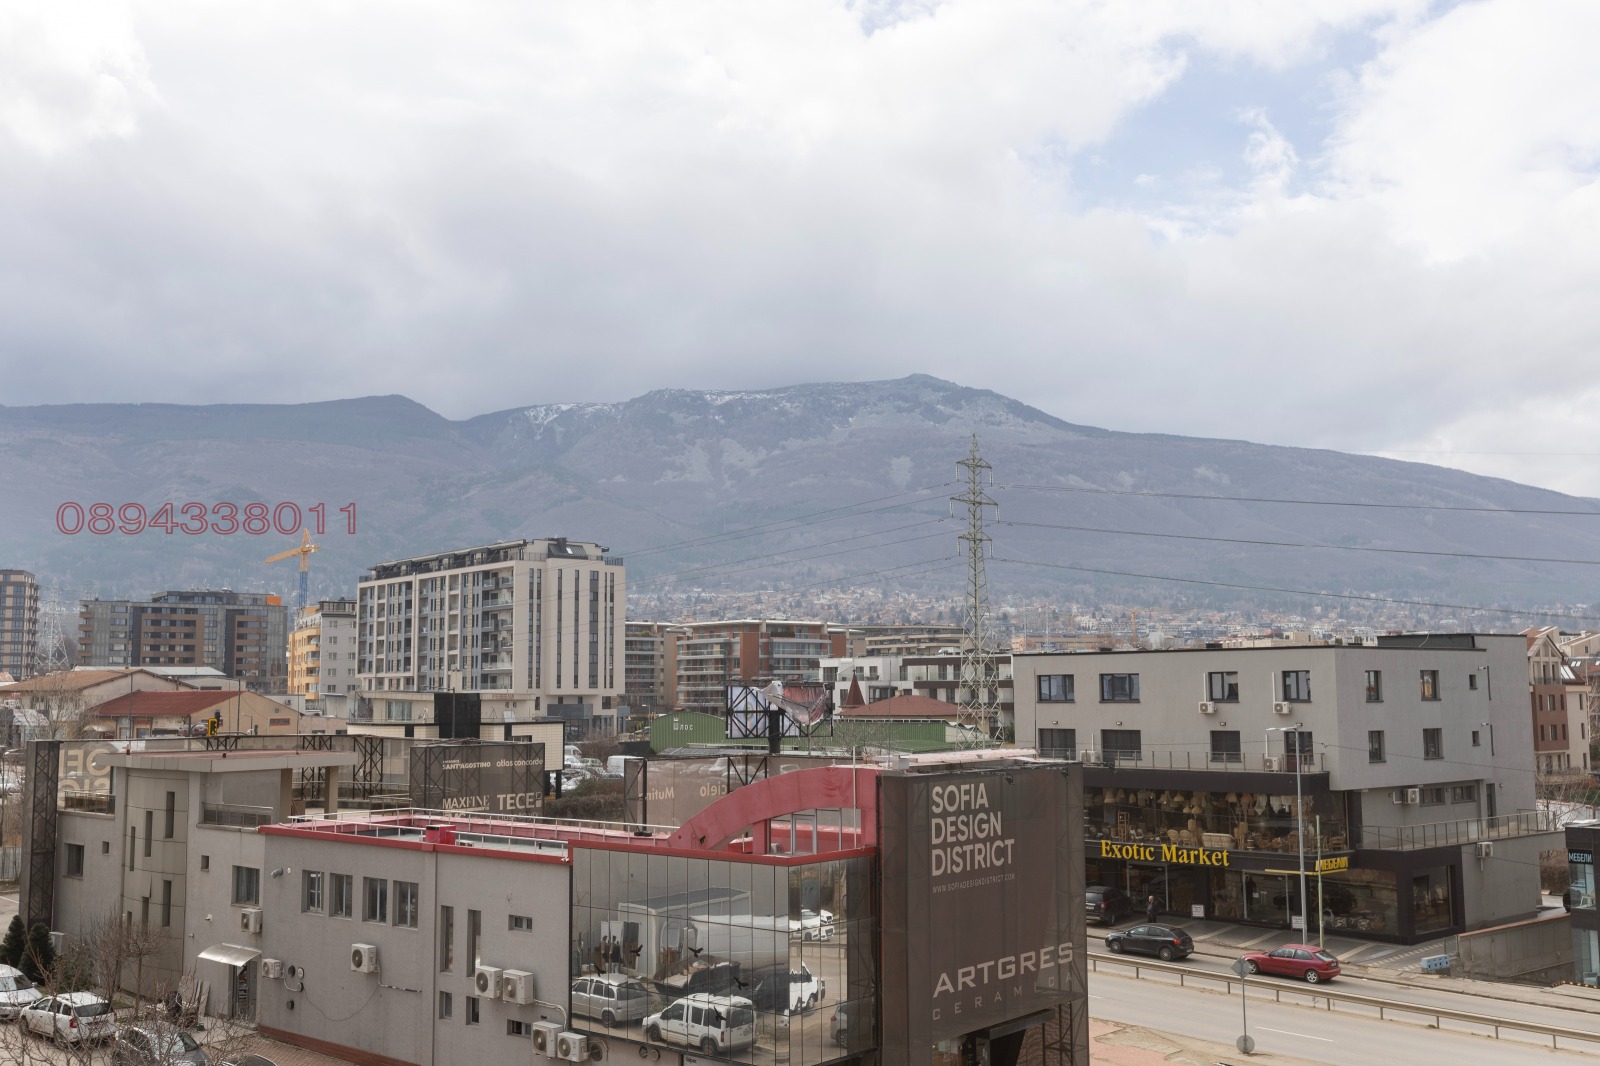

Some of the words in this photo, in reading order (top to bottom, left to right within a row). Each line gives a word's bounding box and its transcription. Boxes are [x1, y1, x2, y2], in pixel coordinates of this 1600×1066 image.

[496, 759, 513, 767] atlas
[514, 758, 544, 767] concorde
[442, 794, 490, 810] MAXFINE
[496, 792, 535, 810] TECE
[931, 782, 989, 814] SOFIA
[931, 811, 1002, 845] DESIGN
[931, 838, 1015, 877] DISTRICT
[1101, 839, 1155, 862] Exotic
[1160, 843, 1230, 867] Market
[1568, 852, 1592, 863] МЕБЕЛИ
[932, 941, 1073, 998] ARTGRES
[932, 972, 1073, 1021] CERAMICA
